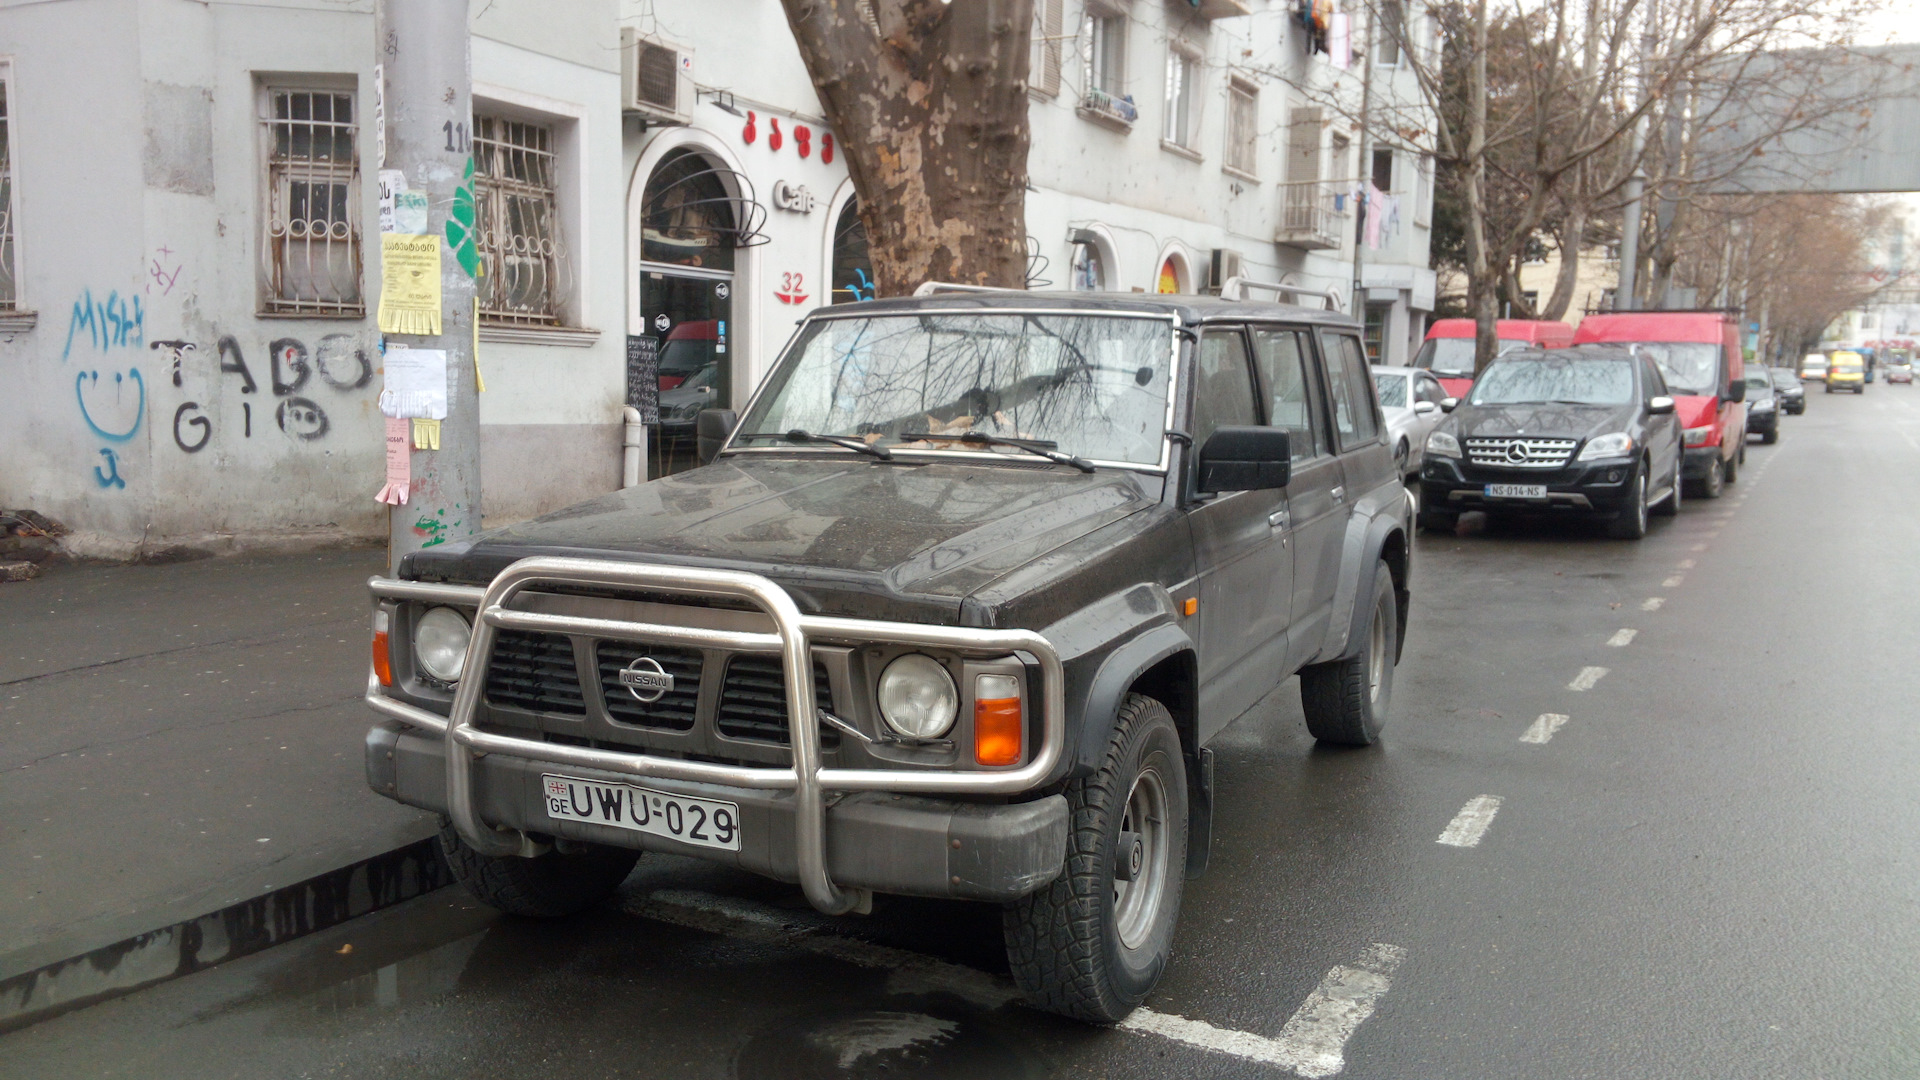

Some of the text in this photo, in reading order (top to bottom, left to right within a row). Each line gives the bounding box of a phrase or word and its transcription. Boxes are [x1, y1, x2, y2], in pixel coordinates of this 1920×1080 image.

[743, 110, 834, 165] კაფე
[772, 179, 816, 214] Cafe
[782, 272, 803, 293] 32
[623, 673, 667, 688] NISSAN
[550, 783, 733, 844] GE UWU-029
